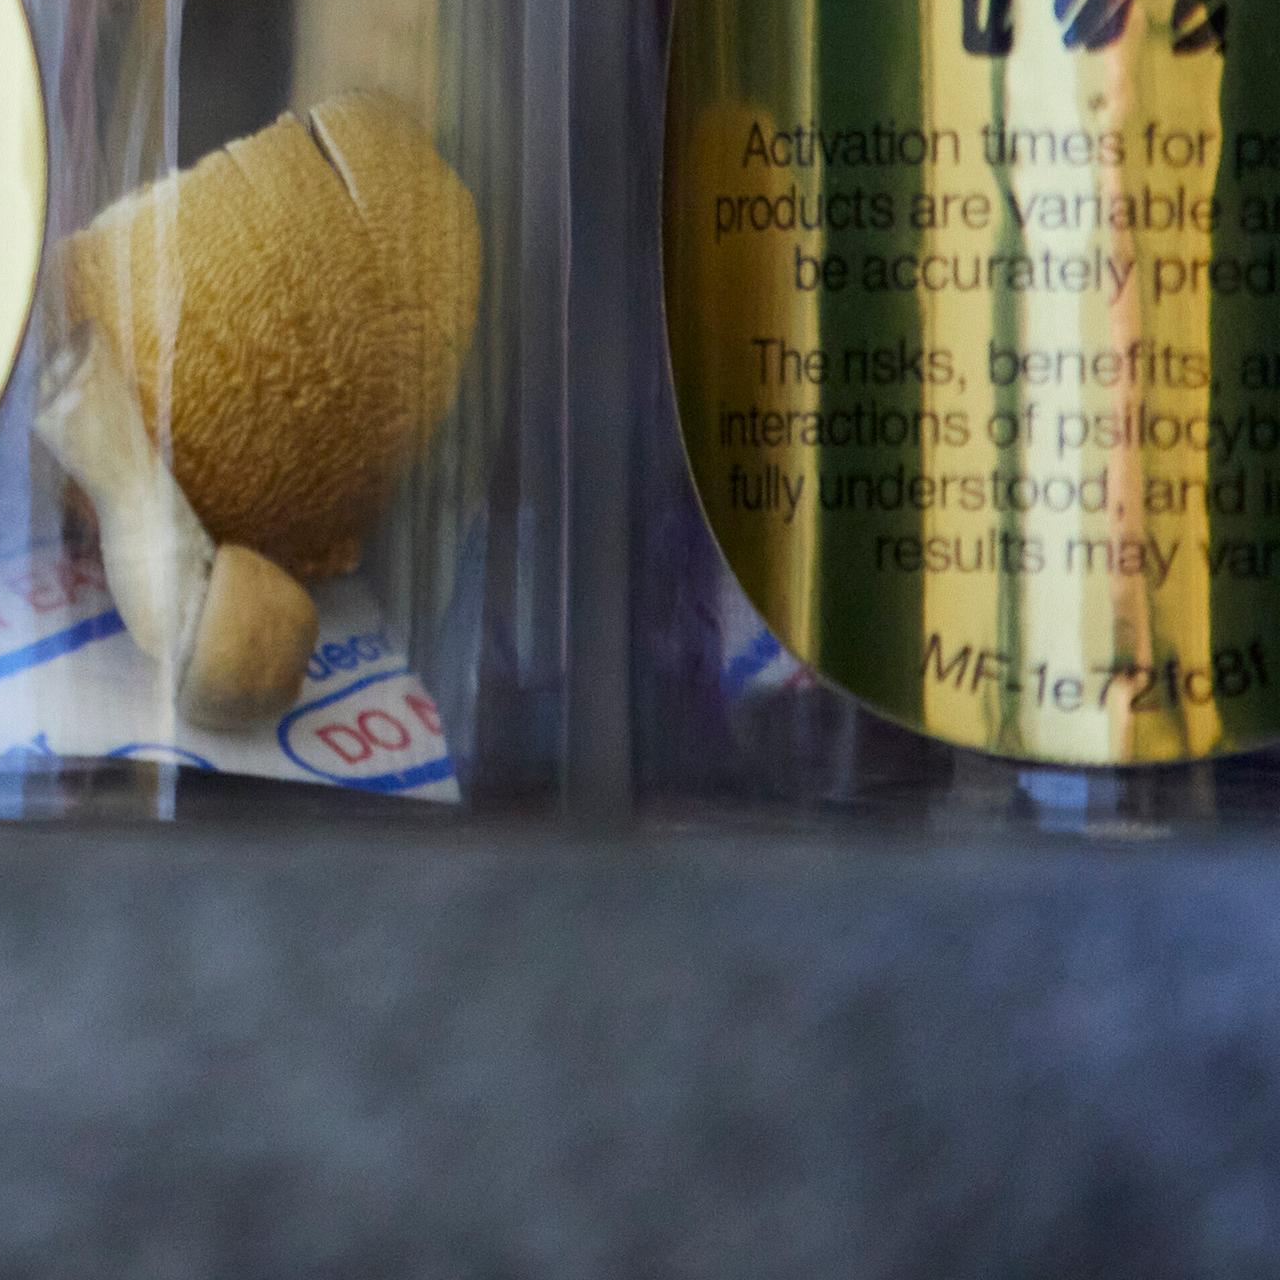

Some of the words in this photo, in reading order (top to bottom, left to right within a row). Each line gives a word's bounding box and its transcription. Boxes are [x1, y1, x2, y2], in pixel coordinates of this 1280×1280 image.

[741, 118, 961, 170] Activation
[981, 120, 1126, 168] times
[1144, 118, 1217, 170] for
[715, 186, 892, 244] products
[908, 194, 992, 230] are
[1005, 185, 1223, 233] variable
[794, 245, 849, 293] be
[863, 247, 1137, 307] accurately
[752, 337, 829, 388] The
[841, 337, 968, 394] risks,
[987, 338, 1223, 400] benefits,
[716, 403, 971, 452] interactions
[985, 402, 1037, 450] of
[1055, 403, 1280, 467] psilocyb
[729, 467, 807, 525] fully
[817, 469, 1126, 521] understood,
[1143, 468, 1248, 516] and
[872, 530, 1046, 576] results
[1063, 536, 1182, 590] may
[1194, 534, 1280, 580] var
[920, 631, 1270, 715] MF-1e72fc8f
[314, 709, 412, 766] DO
